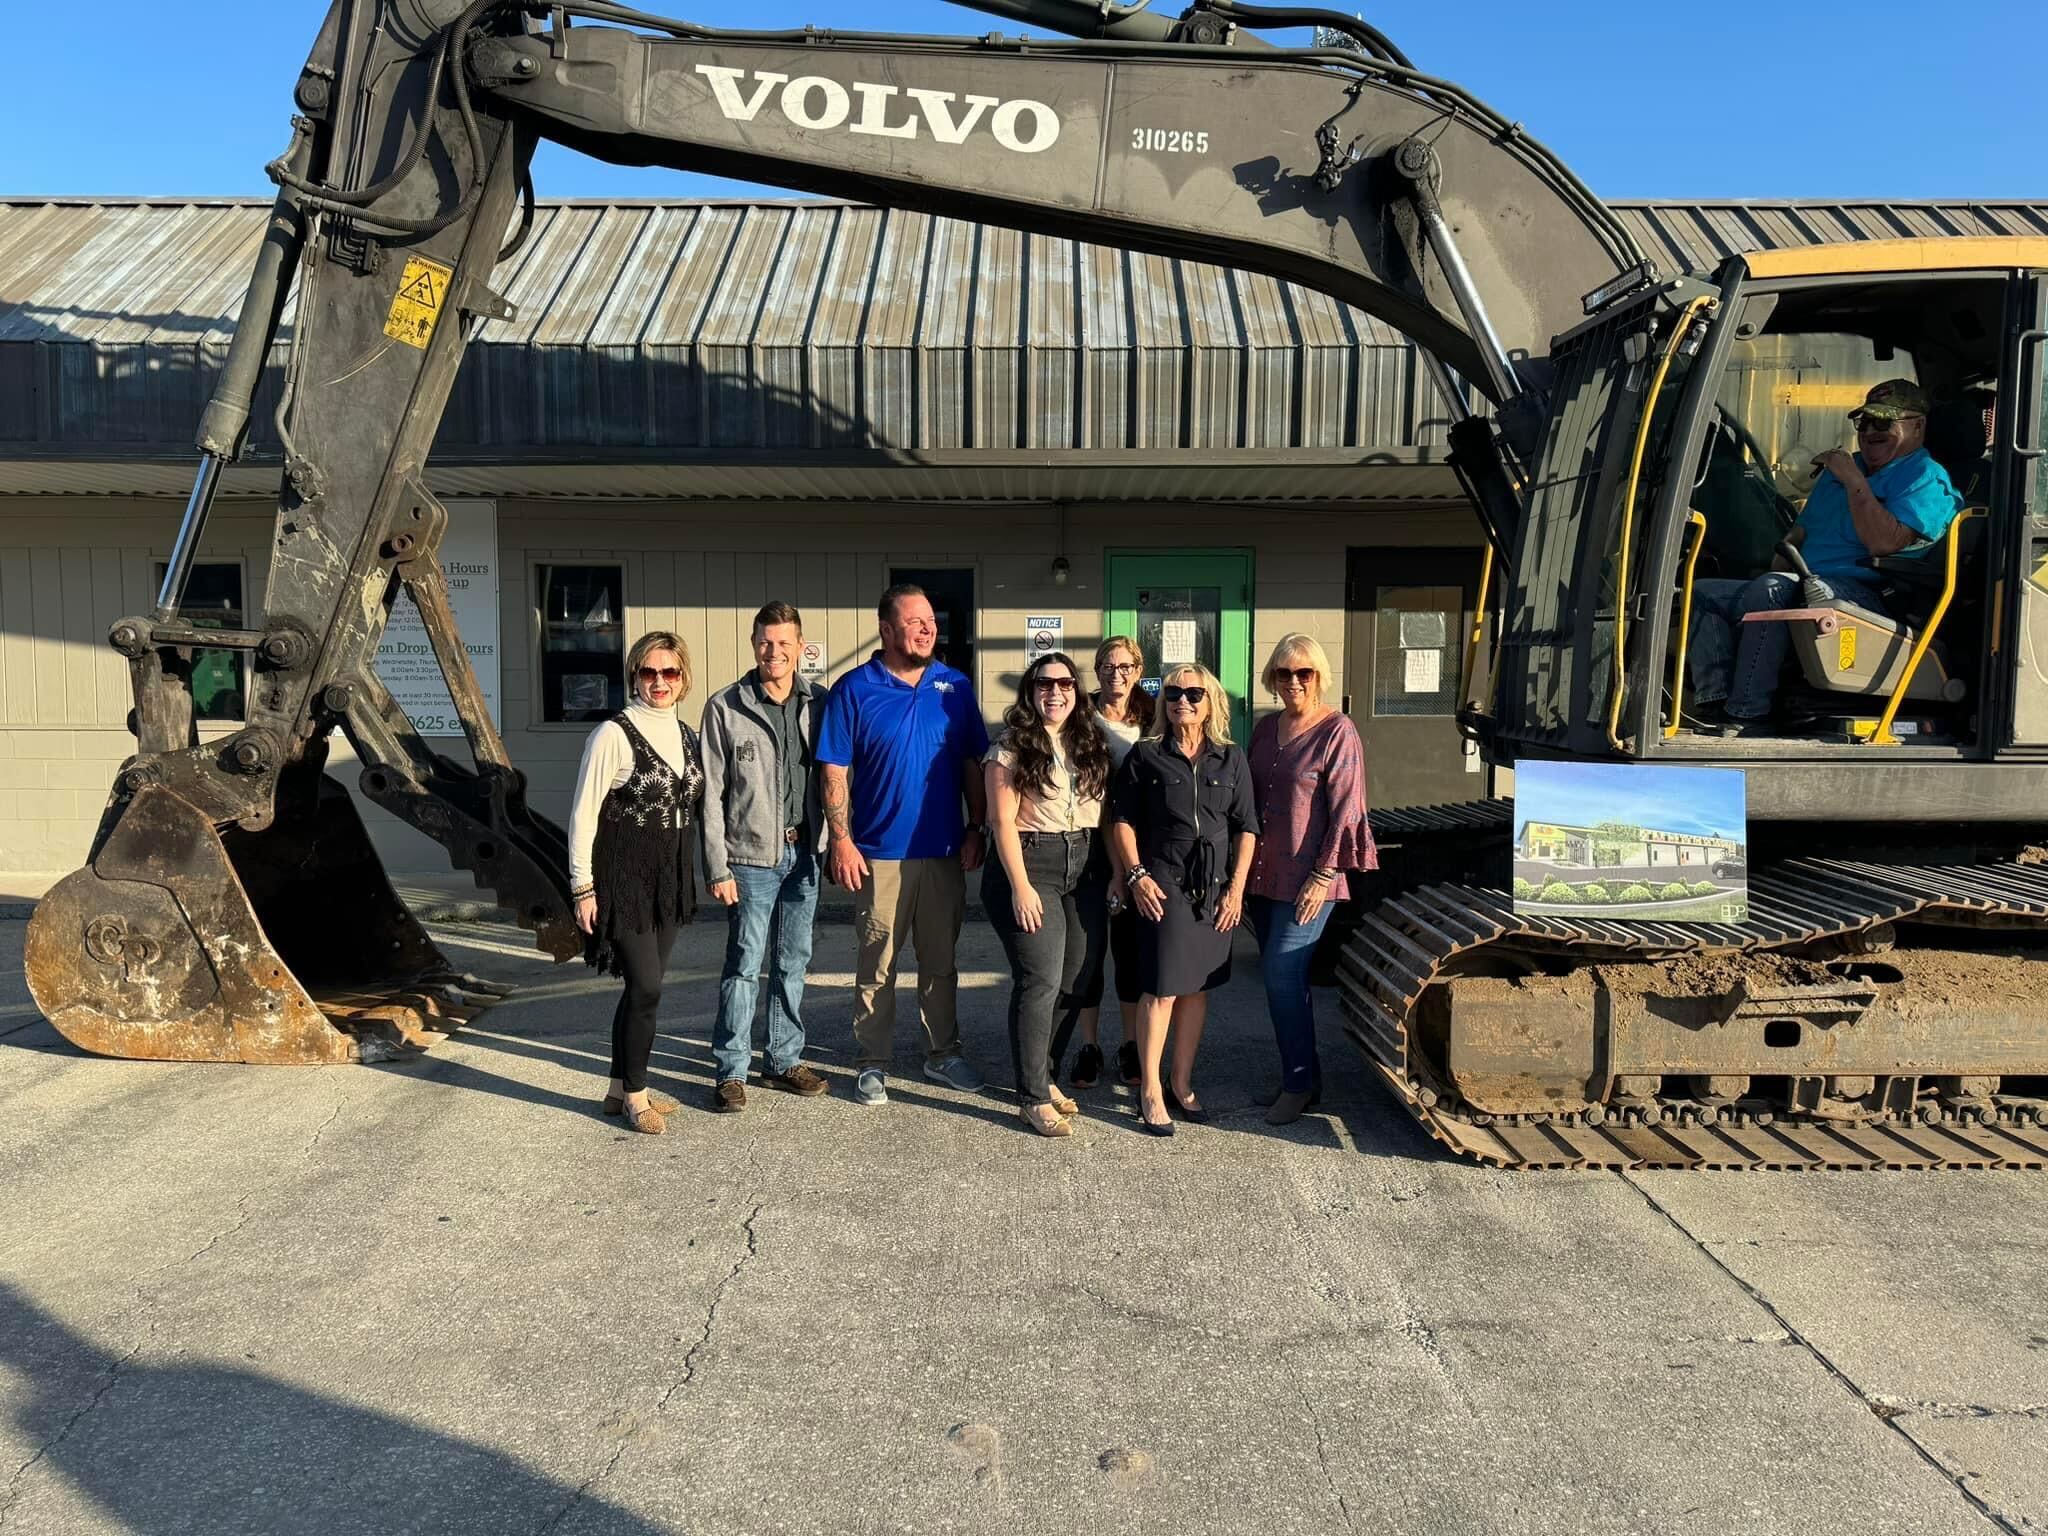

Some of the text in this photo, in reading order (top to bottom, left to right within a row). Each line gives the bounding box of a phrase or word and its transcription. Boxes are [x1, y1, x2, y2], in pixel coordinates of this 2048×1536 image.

[695, 64, 1060, 153] VOLVO
[1131, 127, 1209, 154] 310265
[418, 260, 449, 276] WARNING
[450, 562, 489, 574] Hours
[1029, 618, 1060, 628] NOTICE
[396, 642, 428, 655] Drop
[463, 643, 494, 653] ours
